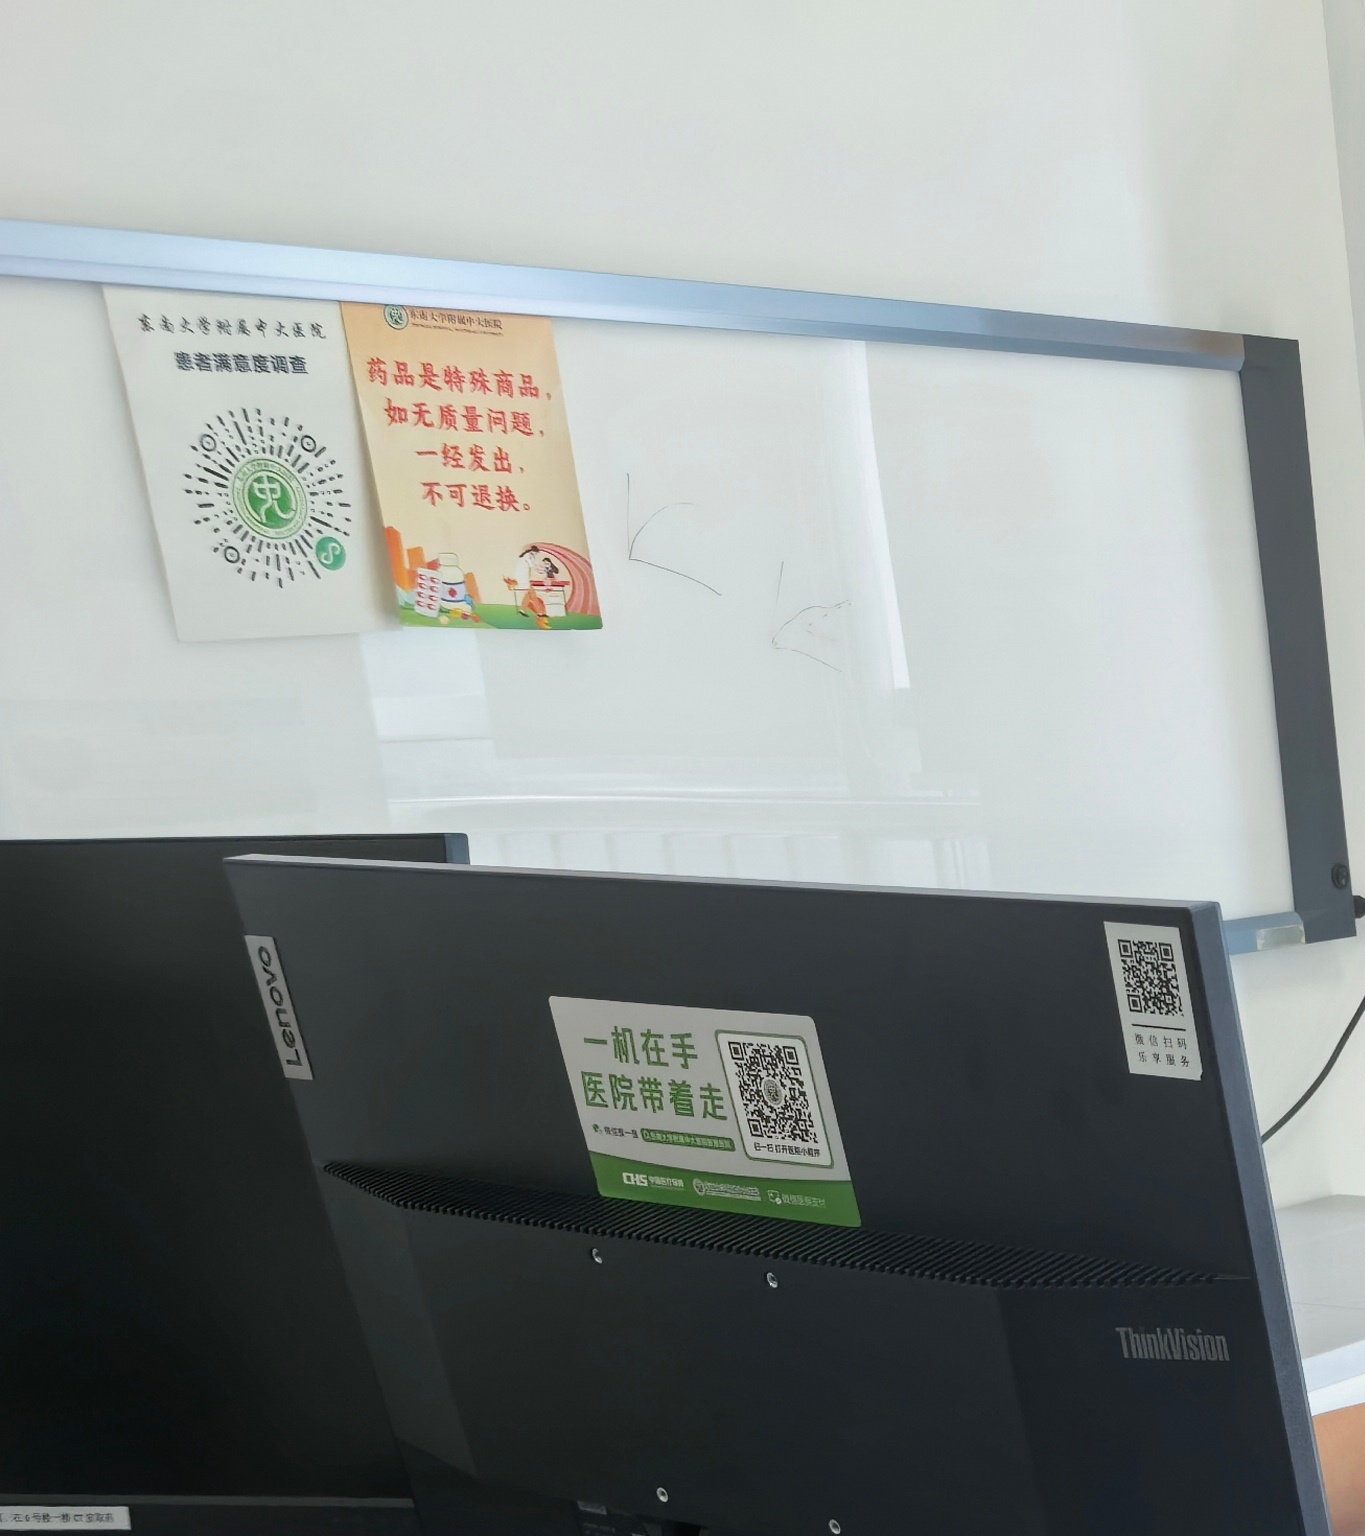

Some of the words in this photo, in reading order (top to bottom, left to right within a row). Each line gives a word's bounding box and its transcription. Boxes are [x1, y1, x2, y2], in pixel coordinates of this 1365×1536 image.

[174, 351, 308, 374] 患者满意度调查
[420, 481, 531, 512] 不可退换。
[257, 945, 303, 1067] Lenovo
[583, 1025, 698, 1069] 一机在手
[1134, 1033, 1187, 1050] 微信扫码
[1138, 1051, 1190, 1068] 乐享服务
[580, 1070, 728, 1121] 医院带着走
[622, 1171, 648, 1187] CHS
[1115, 1326, 1230, 1362] ThinkVision
